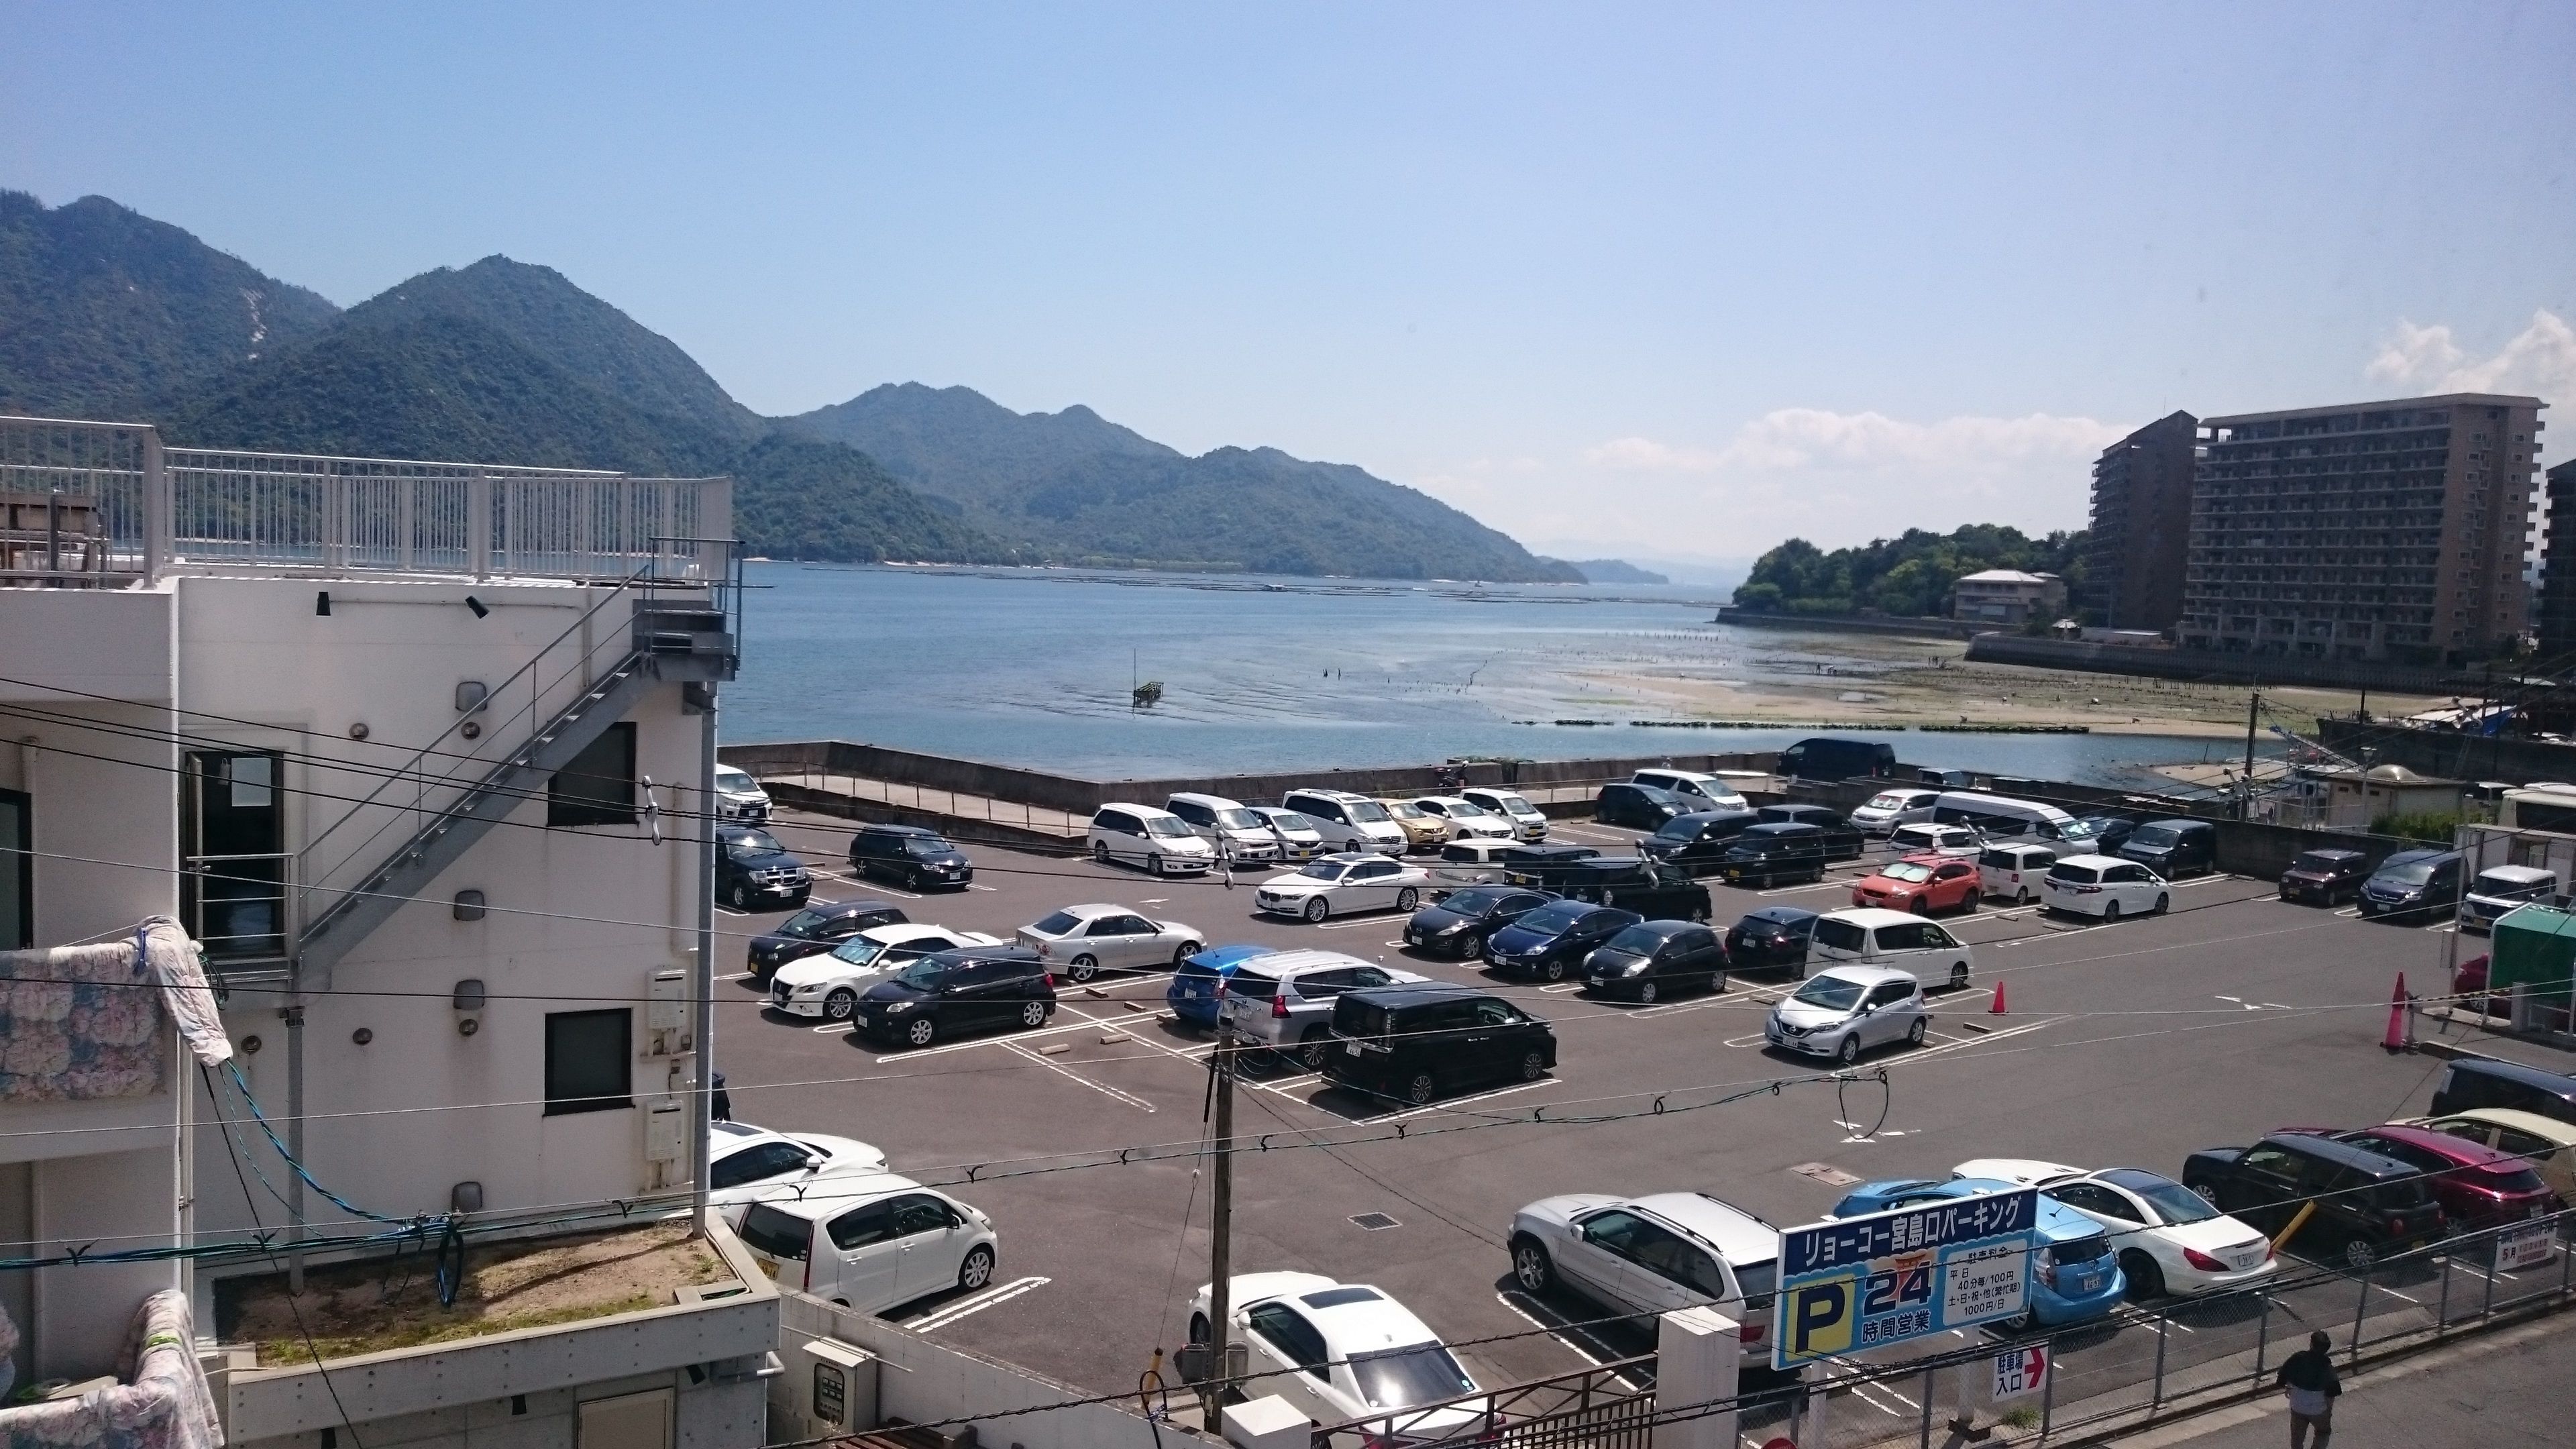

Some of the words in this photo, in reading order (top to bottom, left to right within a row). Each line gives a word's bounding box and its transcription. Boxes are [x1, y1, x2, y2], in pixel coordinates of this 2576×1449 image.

[1805, 1194, 2022, 1267] リョーコー宮島口パーキング
[1949, 1267, 1970, 1281] 平日
[1957, 1271, 2015, 1291] 40分毎/100円
[1862, 1260, 1933, 1318] 24
[1795, 1283, 1845, 1354] P
[1964, 1298, 2005, 1316] 1000円/日
[1861, 1309, 1931, 1343] 時間営業
[1997, 1351, 2024, 1375] 駐車場
[1996, 1373, 2022, 1397] 入口
